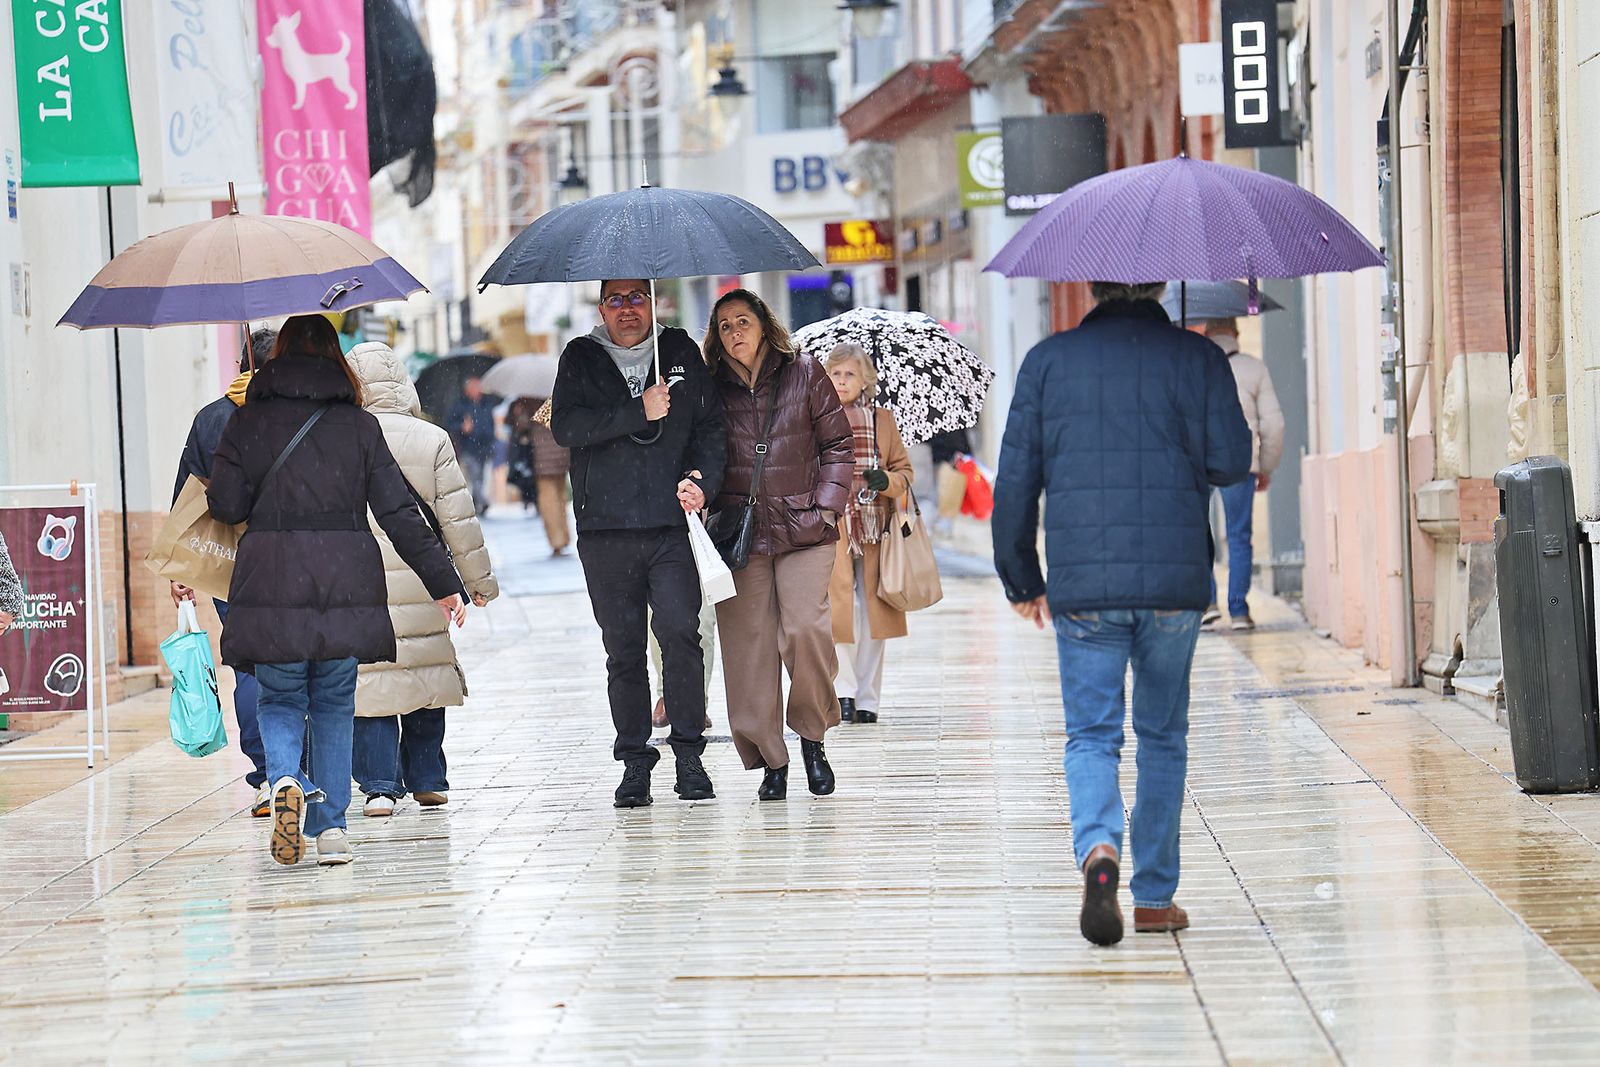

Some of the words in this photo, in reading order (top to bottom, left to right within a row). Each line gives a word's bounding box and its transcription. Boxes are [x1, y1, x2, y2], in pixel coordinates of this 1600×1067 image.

[35, 0, 66, 38] C
[37, 54, 72, 122] LA
[274, 129, 347, 160] CHI
[11, 620, 67, 629] IMPORTANTE
